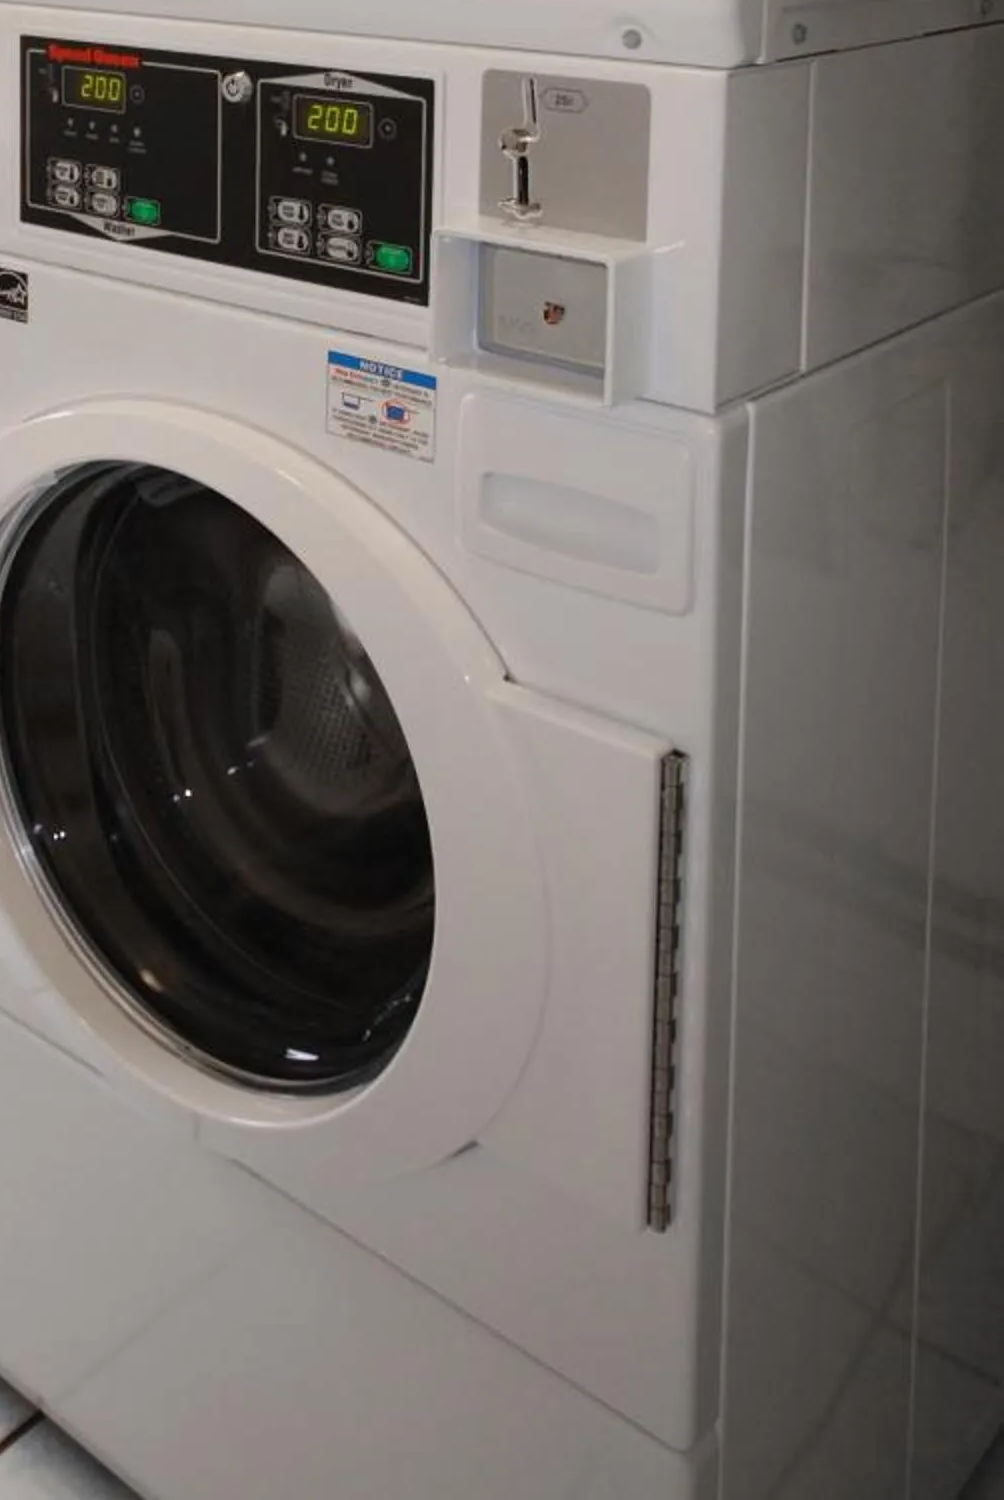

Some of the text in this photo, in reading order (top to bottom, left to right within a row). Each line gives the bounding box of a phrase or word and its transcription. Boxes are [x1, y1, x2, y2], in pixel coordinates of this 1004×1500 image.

[80, 74, 122, 102] 200
[323, 72, 354, 92] Dryer
[307, 104, 359, 135] 200
